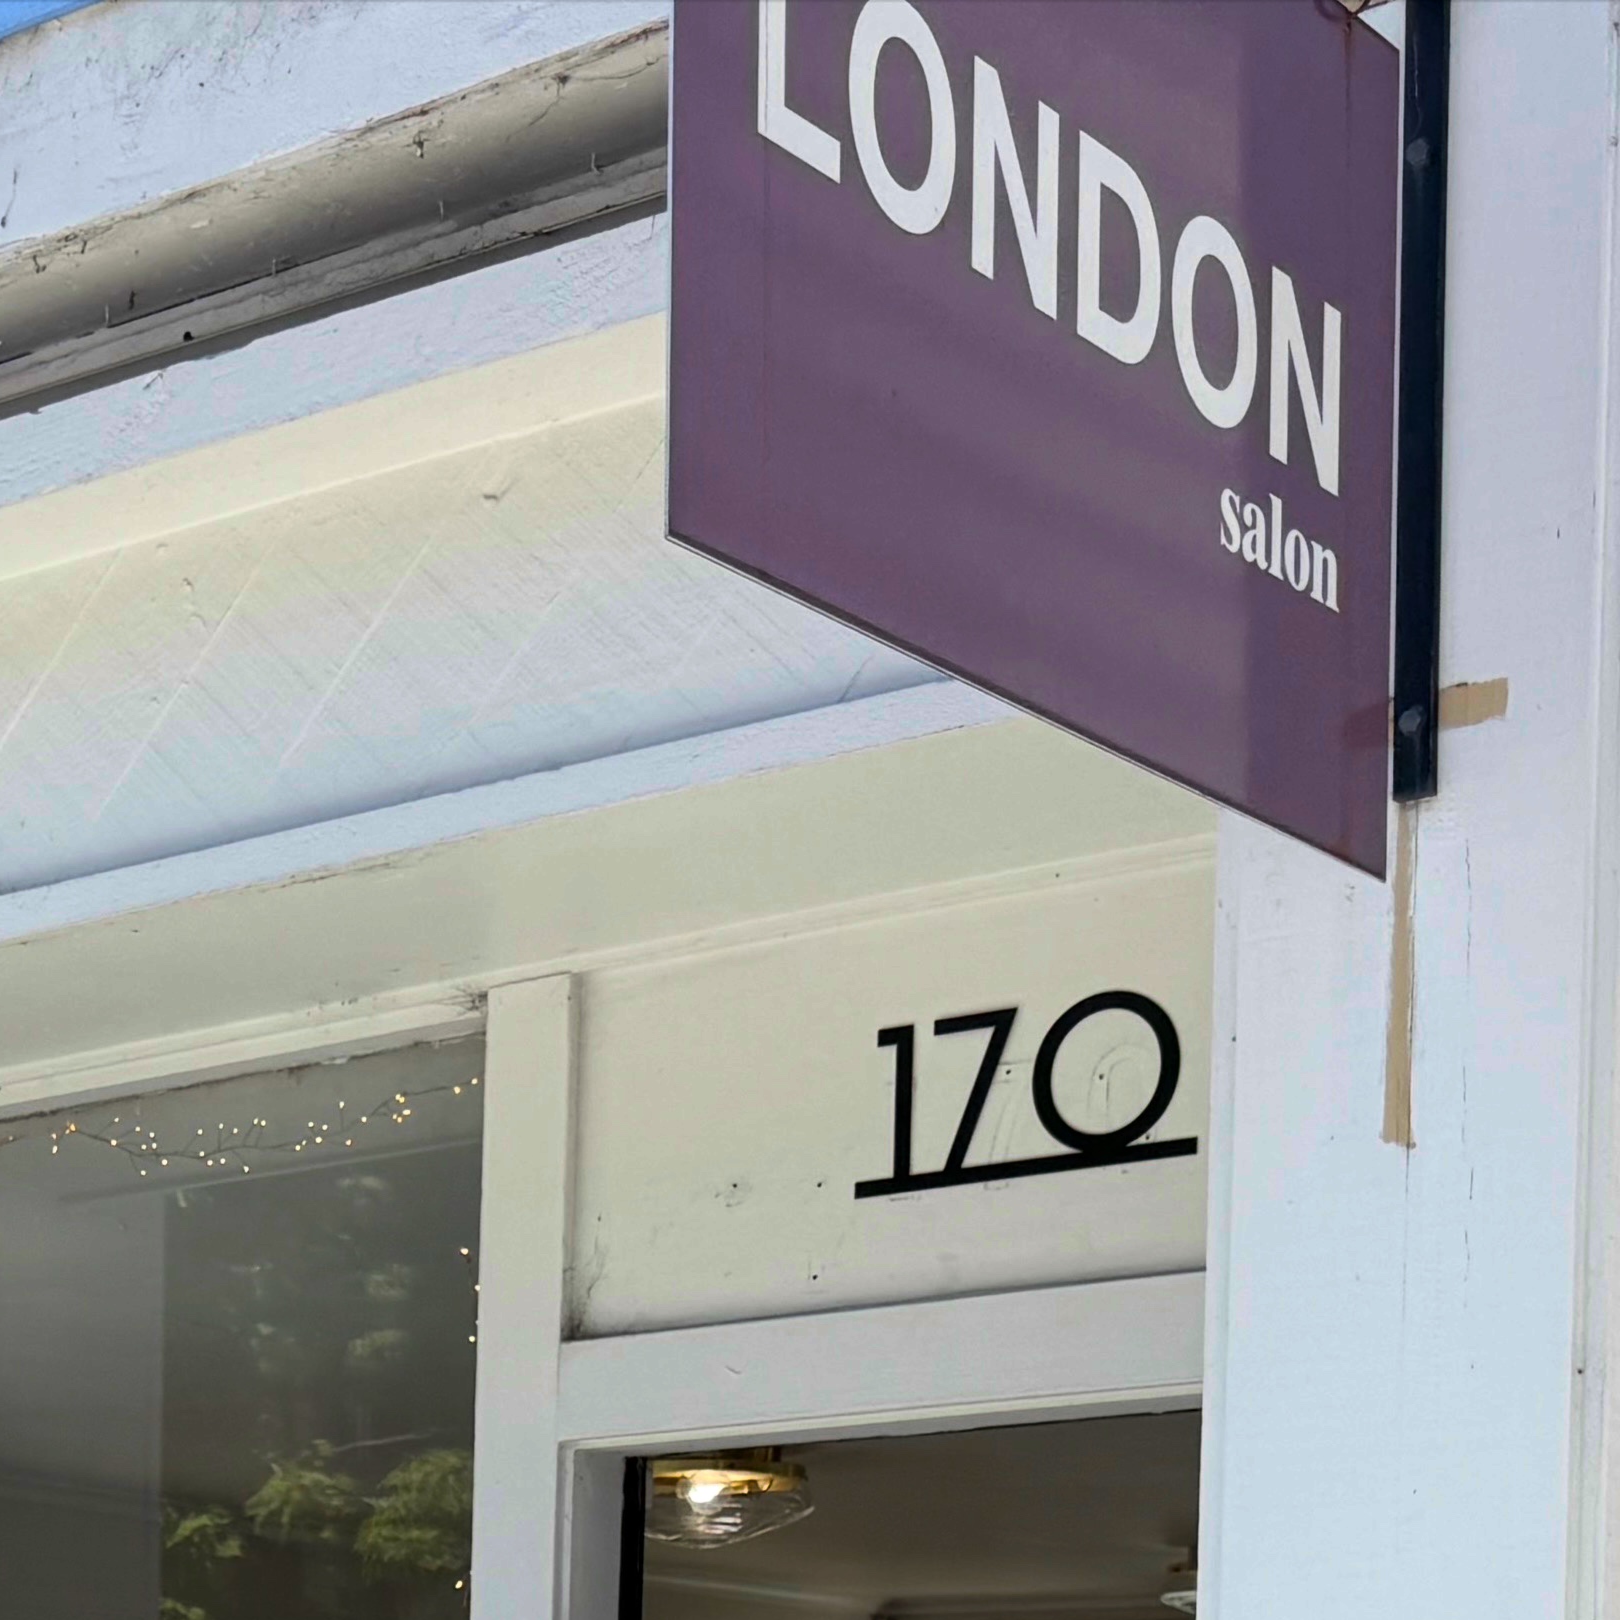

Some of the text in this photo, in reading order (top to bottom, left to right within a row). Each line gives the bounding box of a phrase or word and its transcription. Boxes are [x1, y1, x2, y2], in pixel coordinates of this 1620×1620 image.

[757, 0, 1341, 497] LONDON
[1220, 488, 1340, 613] salon
[875, 990, 1182, 1186] 170
